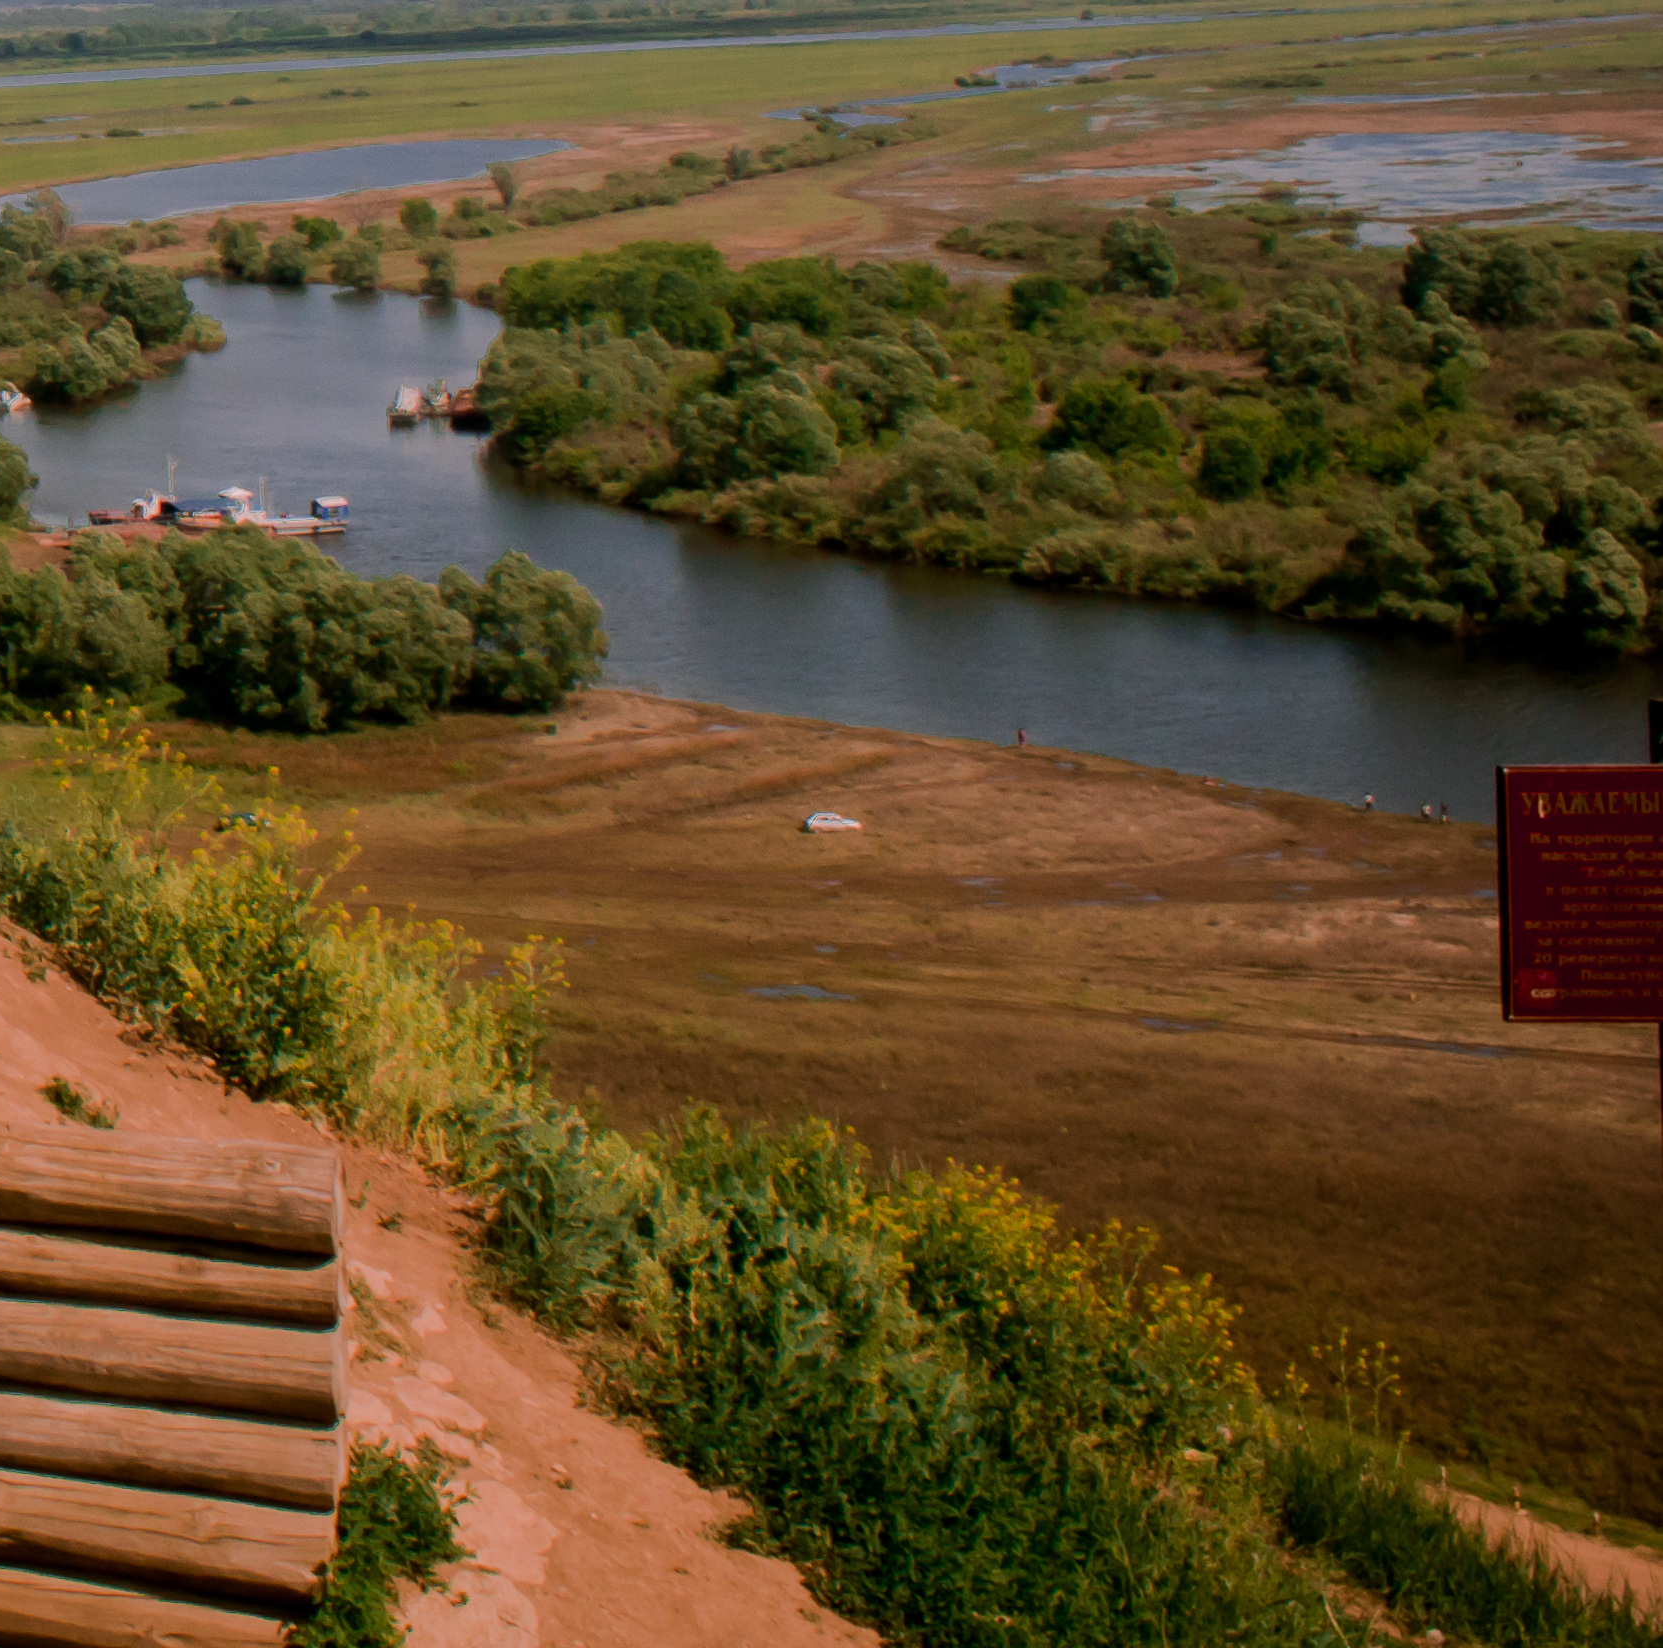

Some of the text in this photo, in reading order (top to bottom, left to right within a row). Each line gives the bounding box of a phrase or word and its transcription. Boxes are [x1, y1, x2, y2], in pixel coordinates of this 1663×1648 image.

[1520, 792, 1663, 815] УВАЖАЕМЫ
[1530, 833, 1550, 843] На
[1533, 953, 1552, 963] 20
